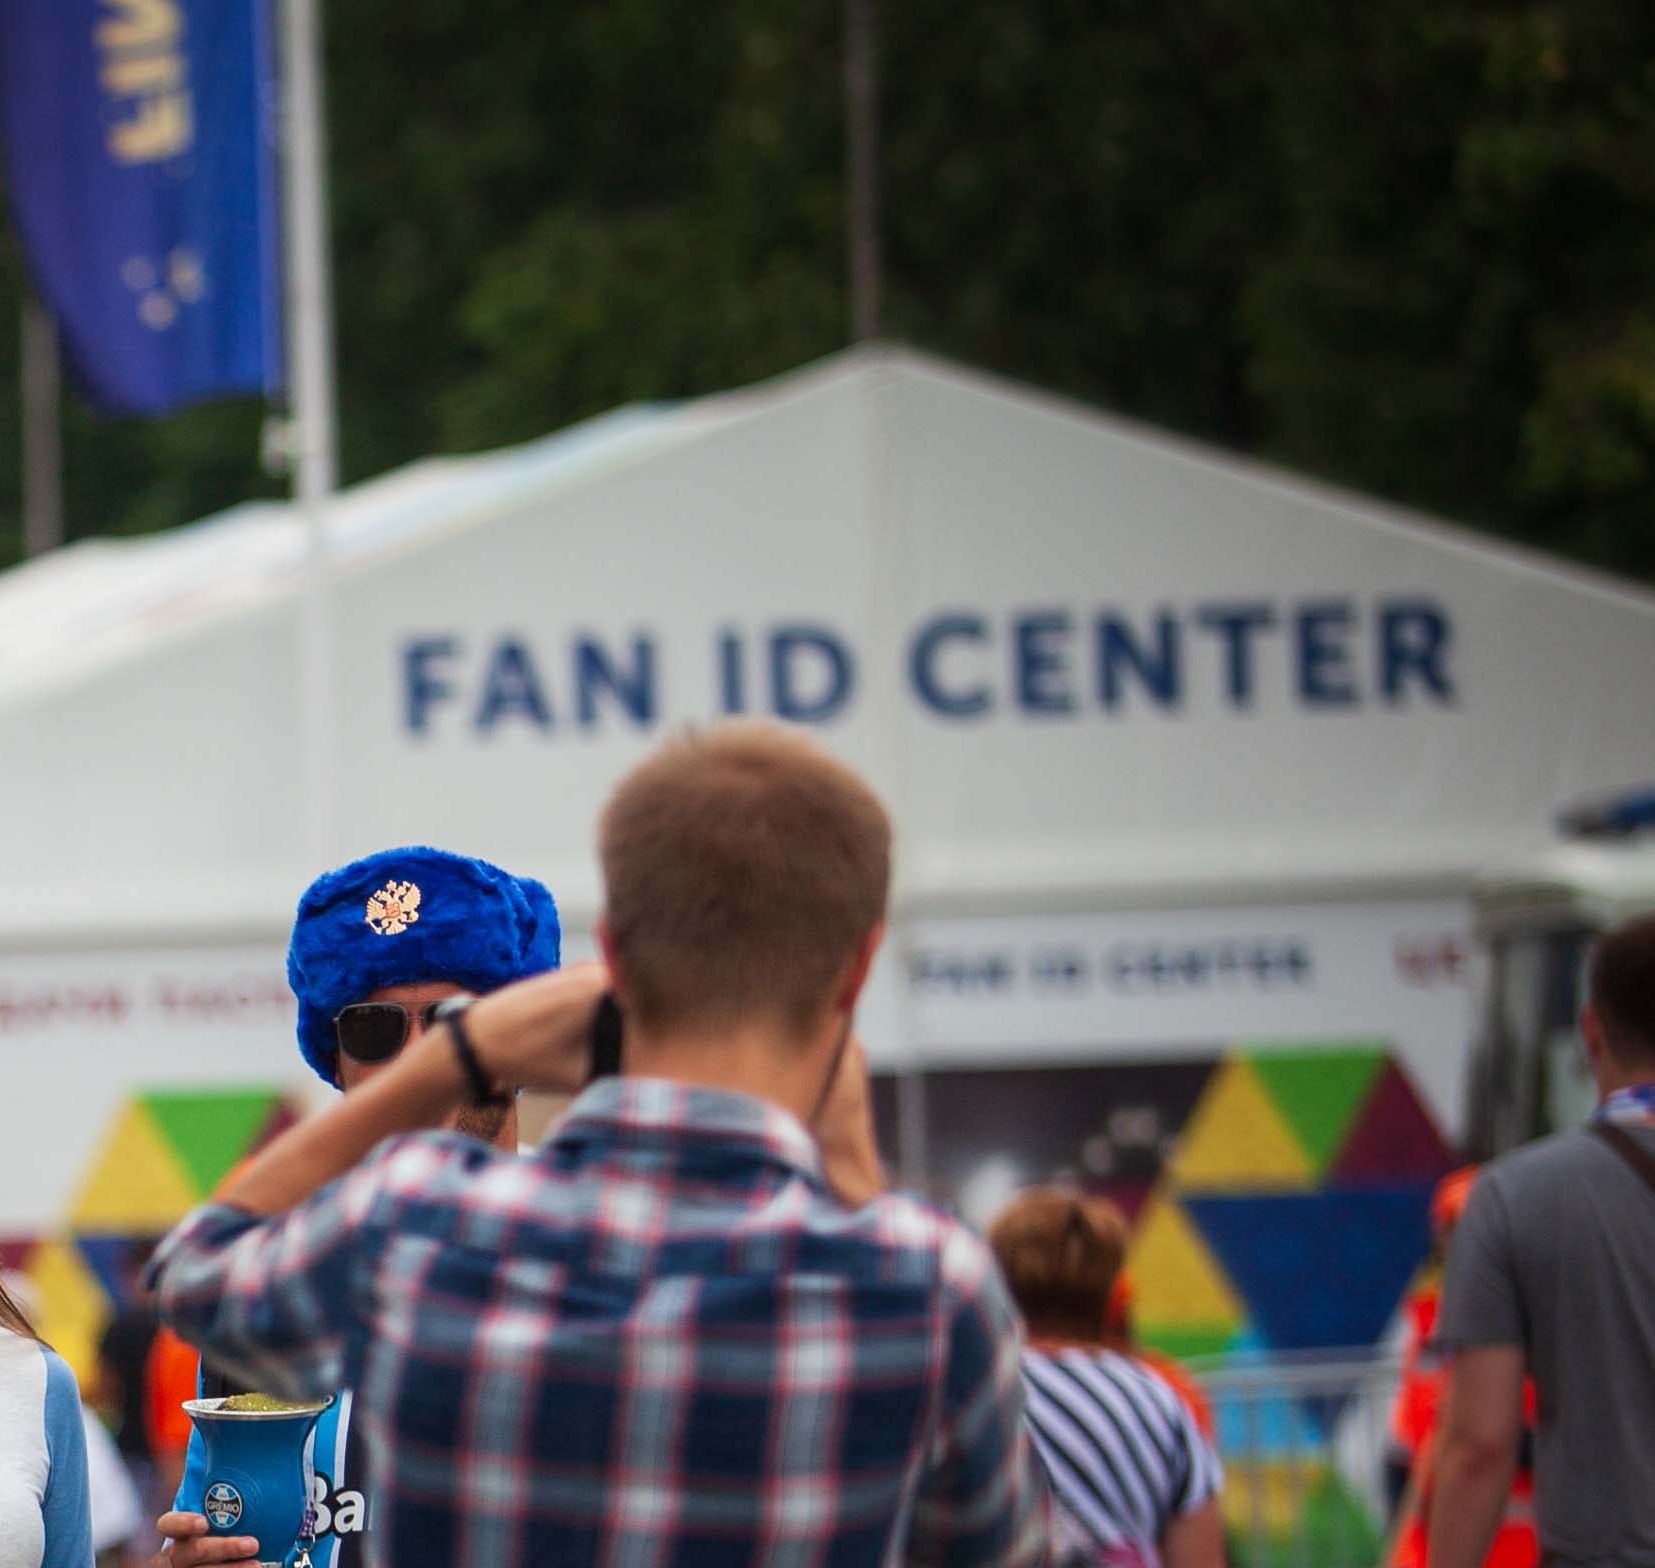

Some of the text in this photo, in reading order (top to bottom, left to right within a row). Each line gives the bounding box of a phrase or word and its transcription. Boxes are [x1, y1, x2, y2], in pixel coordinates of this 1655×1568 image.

[399, 594, 1457, 737] FAN ID CENTER
[1027, 943, 1087, 989] ID
[1105, 932, 1314, 988] CENTER
